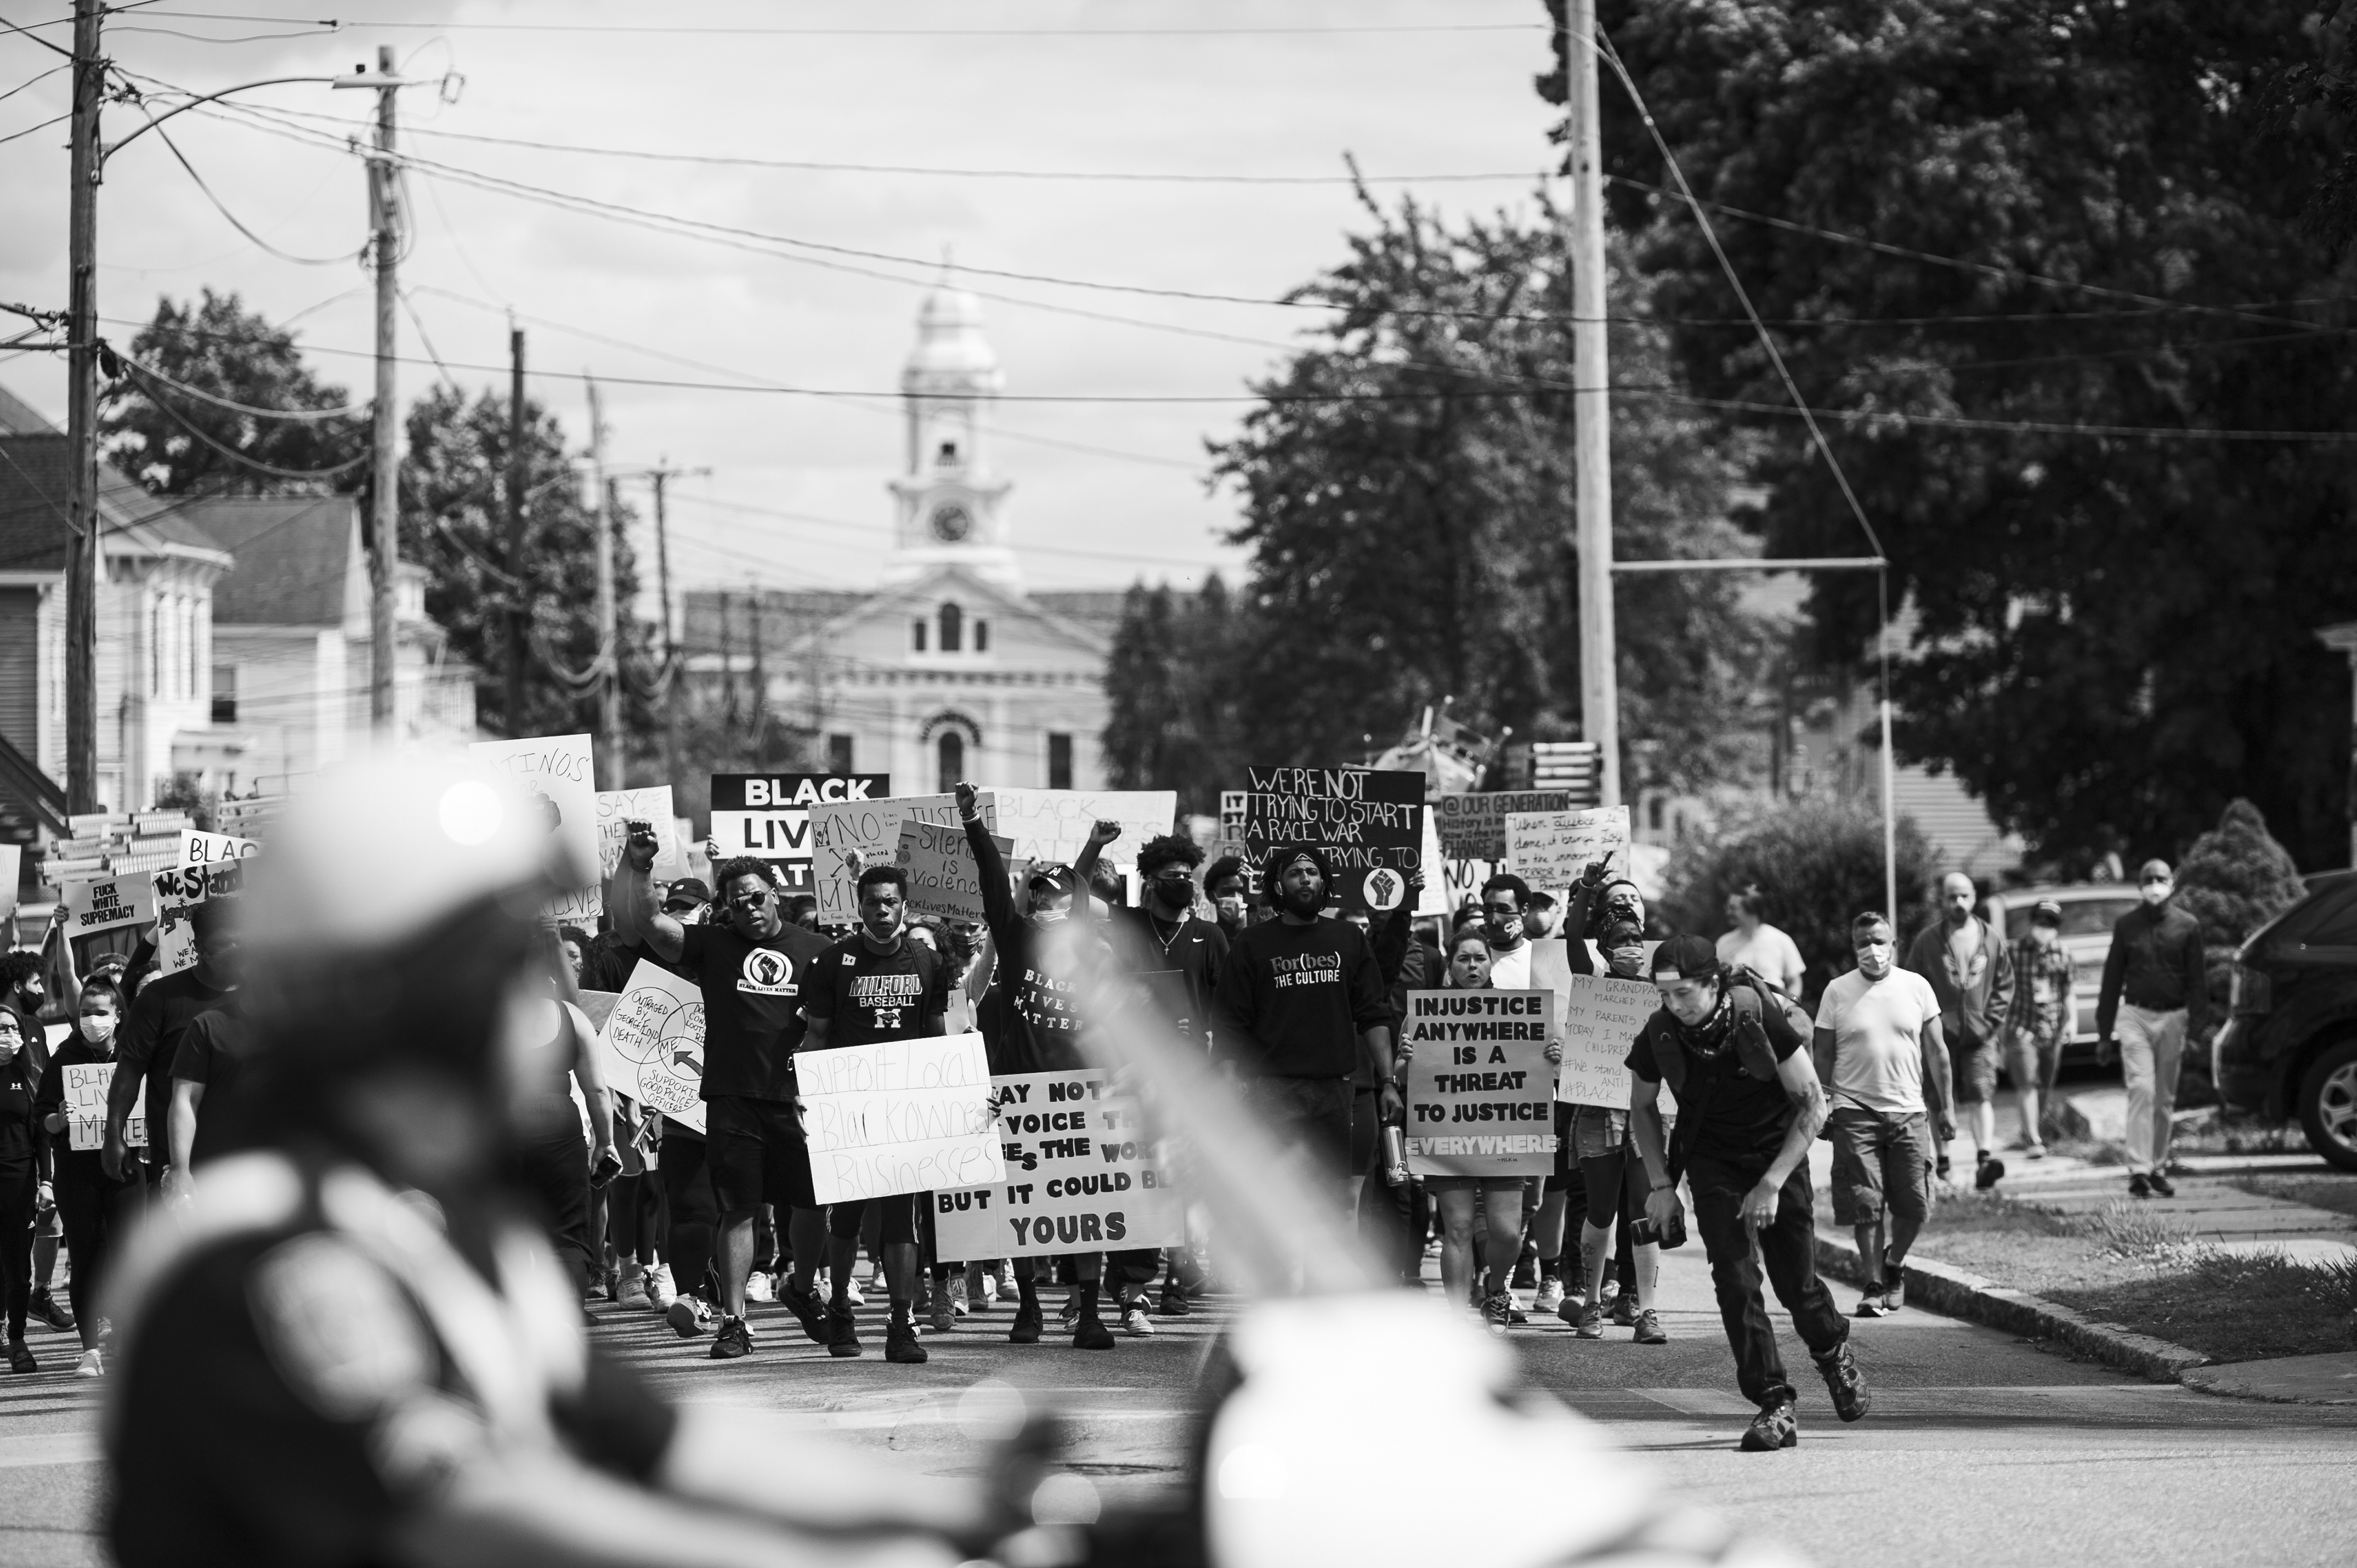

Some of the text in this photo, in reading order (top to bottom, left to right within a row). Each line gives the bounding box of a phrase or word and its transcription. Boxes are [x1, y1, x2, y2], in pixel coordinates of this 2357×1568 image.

[489, 747, 590, 782] ATINOS
[745, 778, 873, 806] BLACK
[1324, 769, 1371, 800] NOT
[597, 790, 640, 817] SAY
[999, 795, 1097, 820] BLACK
[1247, 793, 1418, 830] TRYING TO START
[1493, 793, 1569, 814] GENERATION
[834, 812, 881, 845] NO
[907, 805, 996, 832] JUSTE
[1058, 819, 1164, 841] LIES
[744, 817, 809, 849] LIV
[919, 824, 975, 860] Silen
[1247, 819, 1264, 840] A
[1268, 819, 1317, 841] RACE
[1320, 822, 1363, 843] WAR
[190, 838, 258, 862] BLAC
[1317, 846, 1420, 869] TRYING TO
[1442, 839, 1493, 857] CHANGE
[942, 857, 958, 875] is
[93, 882, 117, 898] FUCK
[154, 871, 184, 898] We
[913, 868, 984, 897] Violenc
[92, 894, 120, 911] WHITE
[80, 904, 135, 927] SUPREMACY
[173, 958, 187, 968] WE
[177, 948, 190, 957] WE
[849, 974, 923, 997] MILFORD
[1024, 968, 1078, 994] BLACK
[1274, 969, 1340, 989] THE CULTURE
[1573, 976, 1659, 995] MY GRANDPA
[632, 991, 668, 1015] OUTRAGED
[859, 996, 915, 1007] BASEBALL
[1021, 987, 1079, 1013] LIVES
[1415, 996, 1542, 1016] INJUSTICE
[1595, 993, 1660, 1008] MARCHED FOR
[636, 1006, 649, 1020] BY
[1569, 1005, 1585, 1016] MY
[1595, 1010, 1637, 1025] PARENTS
[613, 1027, 643, 1048] DEATH
[1412, 1021, 1545, 1041] ANYWHERE
[659, 1040, 678, 1055] ME
[1453, 1045, 1506, 1065] IS A
[1585, 1041, 1633, 1056] CHILDREN
[69, 1068, 116, 1089] BLA
[1434, 1070, 1527, 1093] THREAT
[1594, 1065, 1622, 1076] stand
[640, 1077, 694, 1108] GOOD POLICE
[649, 1069, 700, 1102] SUPPORTS
[999, 1080, 1104, 1105] AY NOT
[1562, 1080, 1618, 1102] #BLACK
[648, 1093, 683, 1113] OFFICERS
[1413, 1102, 1549, 1123] TO JUSTICE
[1005, 1111, 1086, 1135] VOICE
[1039, 1138, 1091, 1159] THE
[1100, 1140, 1154, 1163] WOR
[1404, 1134, 1558, 1156] EVERYWHERE
[937, 1189, 991, 1214] BUT
[1007, 1183, 1034, 1205] IT
[1046, 1172, 1131, 1198] COULD
[1009, 1211, 1126, 1246] YOURS
